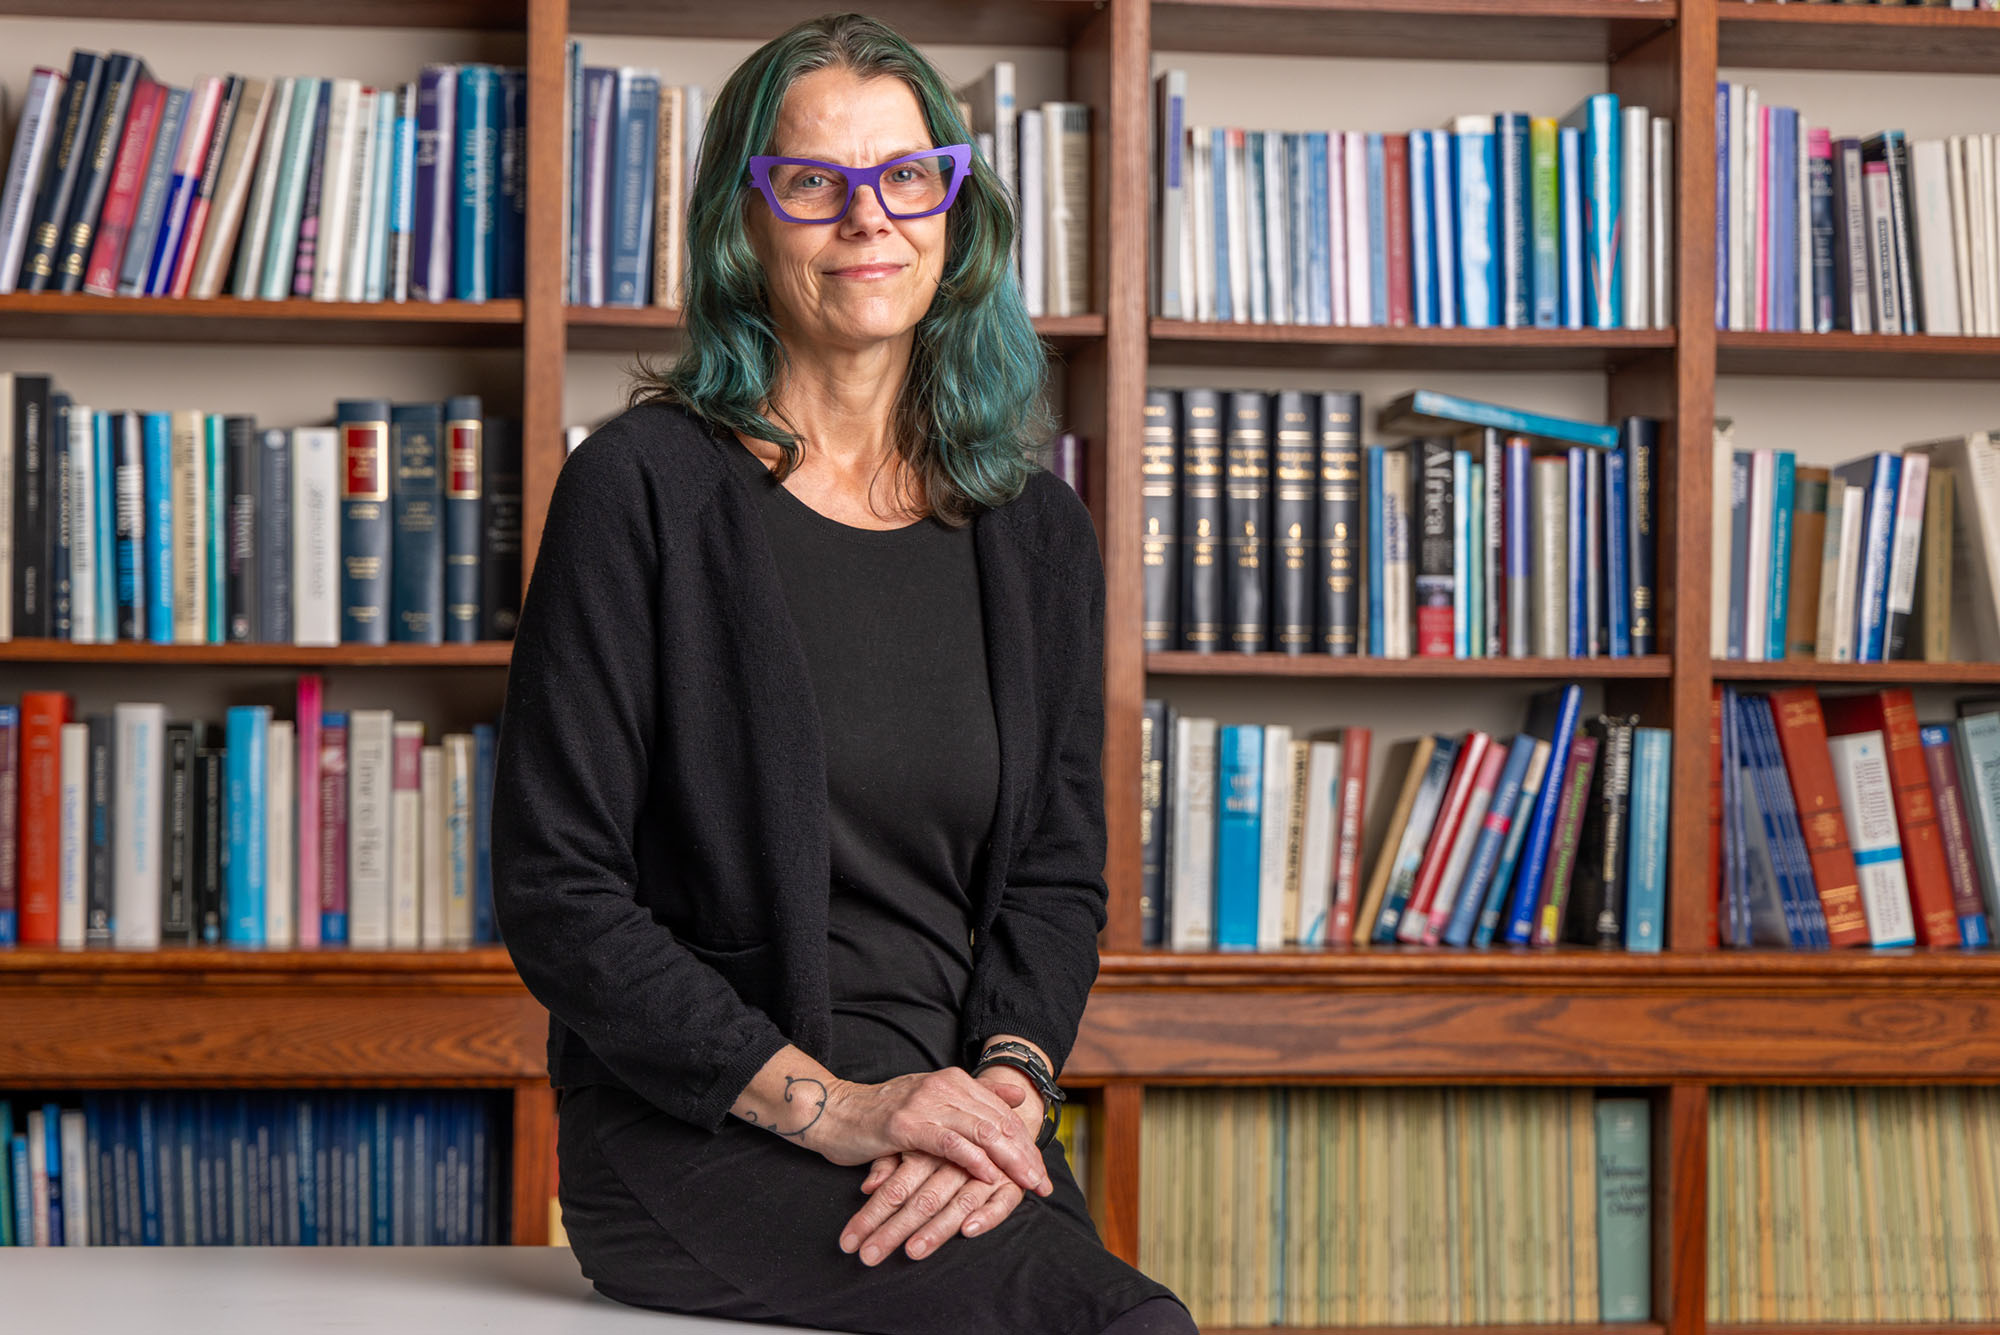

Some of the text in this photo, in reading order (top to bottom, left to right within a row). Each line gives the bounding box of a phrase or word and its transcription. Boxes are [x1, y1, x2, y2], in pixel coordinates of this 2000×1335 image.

[1424, 442, 1454, 536] Africa
[359, 747, 382, 797] Time
[358, 828, 382, 878] Heal
